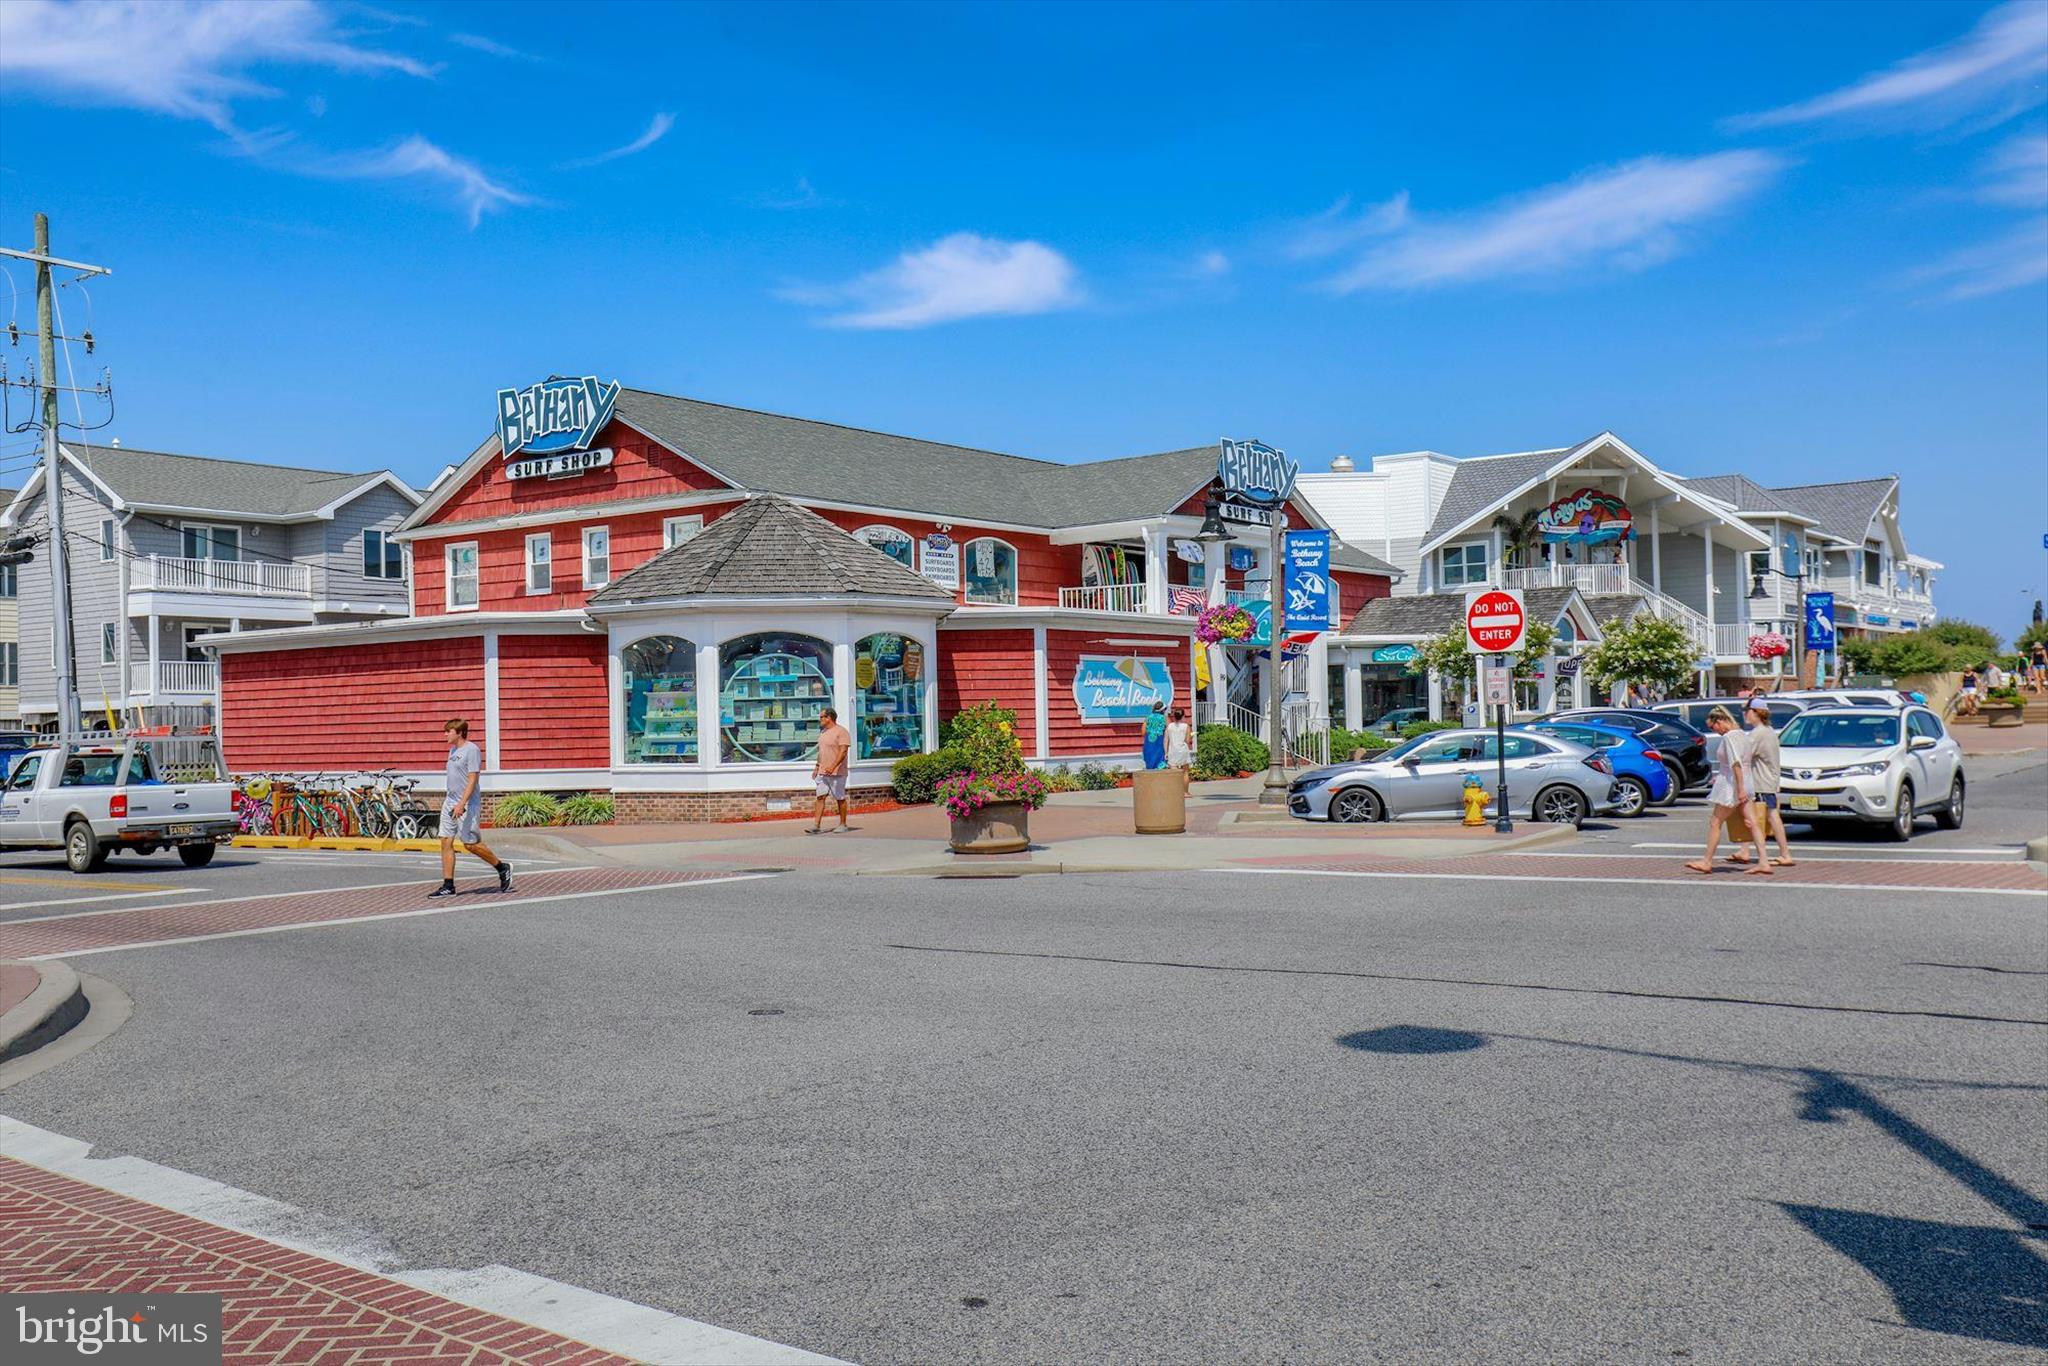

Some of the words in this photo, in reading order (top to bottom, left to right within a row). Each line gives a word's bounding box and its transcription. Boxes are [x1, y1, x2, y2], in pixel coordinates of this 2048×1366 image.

[514, 459, 553, 477] SURF
[561, 452, 602, 470] SHOP
[1226, 505, 1253, 520] SURF
[1290, 539, 1316, 547] Welcome
[1291, 548, 1323, 560] Bethany
[1295, 558, 1319, 567] Beach
[1475, 604, 1488, 614] DO
[1494, 602, 1514, 612] NOT
[1311, 613, 1327, 621] Resort
[1480, 629, 1512, 640] ENTER
[1083, 670, 1122, 692] Bethany
[1092, 687, 1127, 708] Beach
